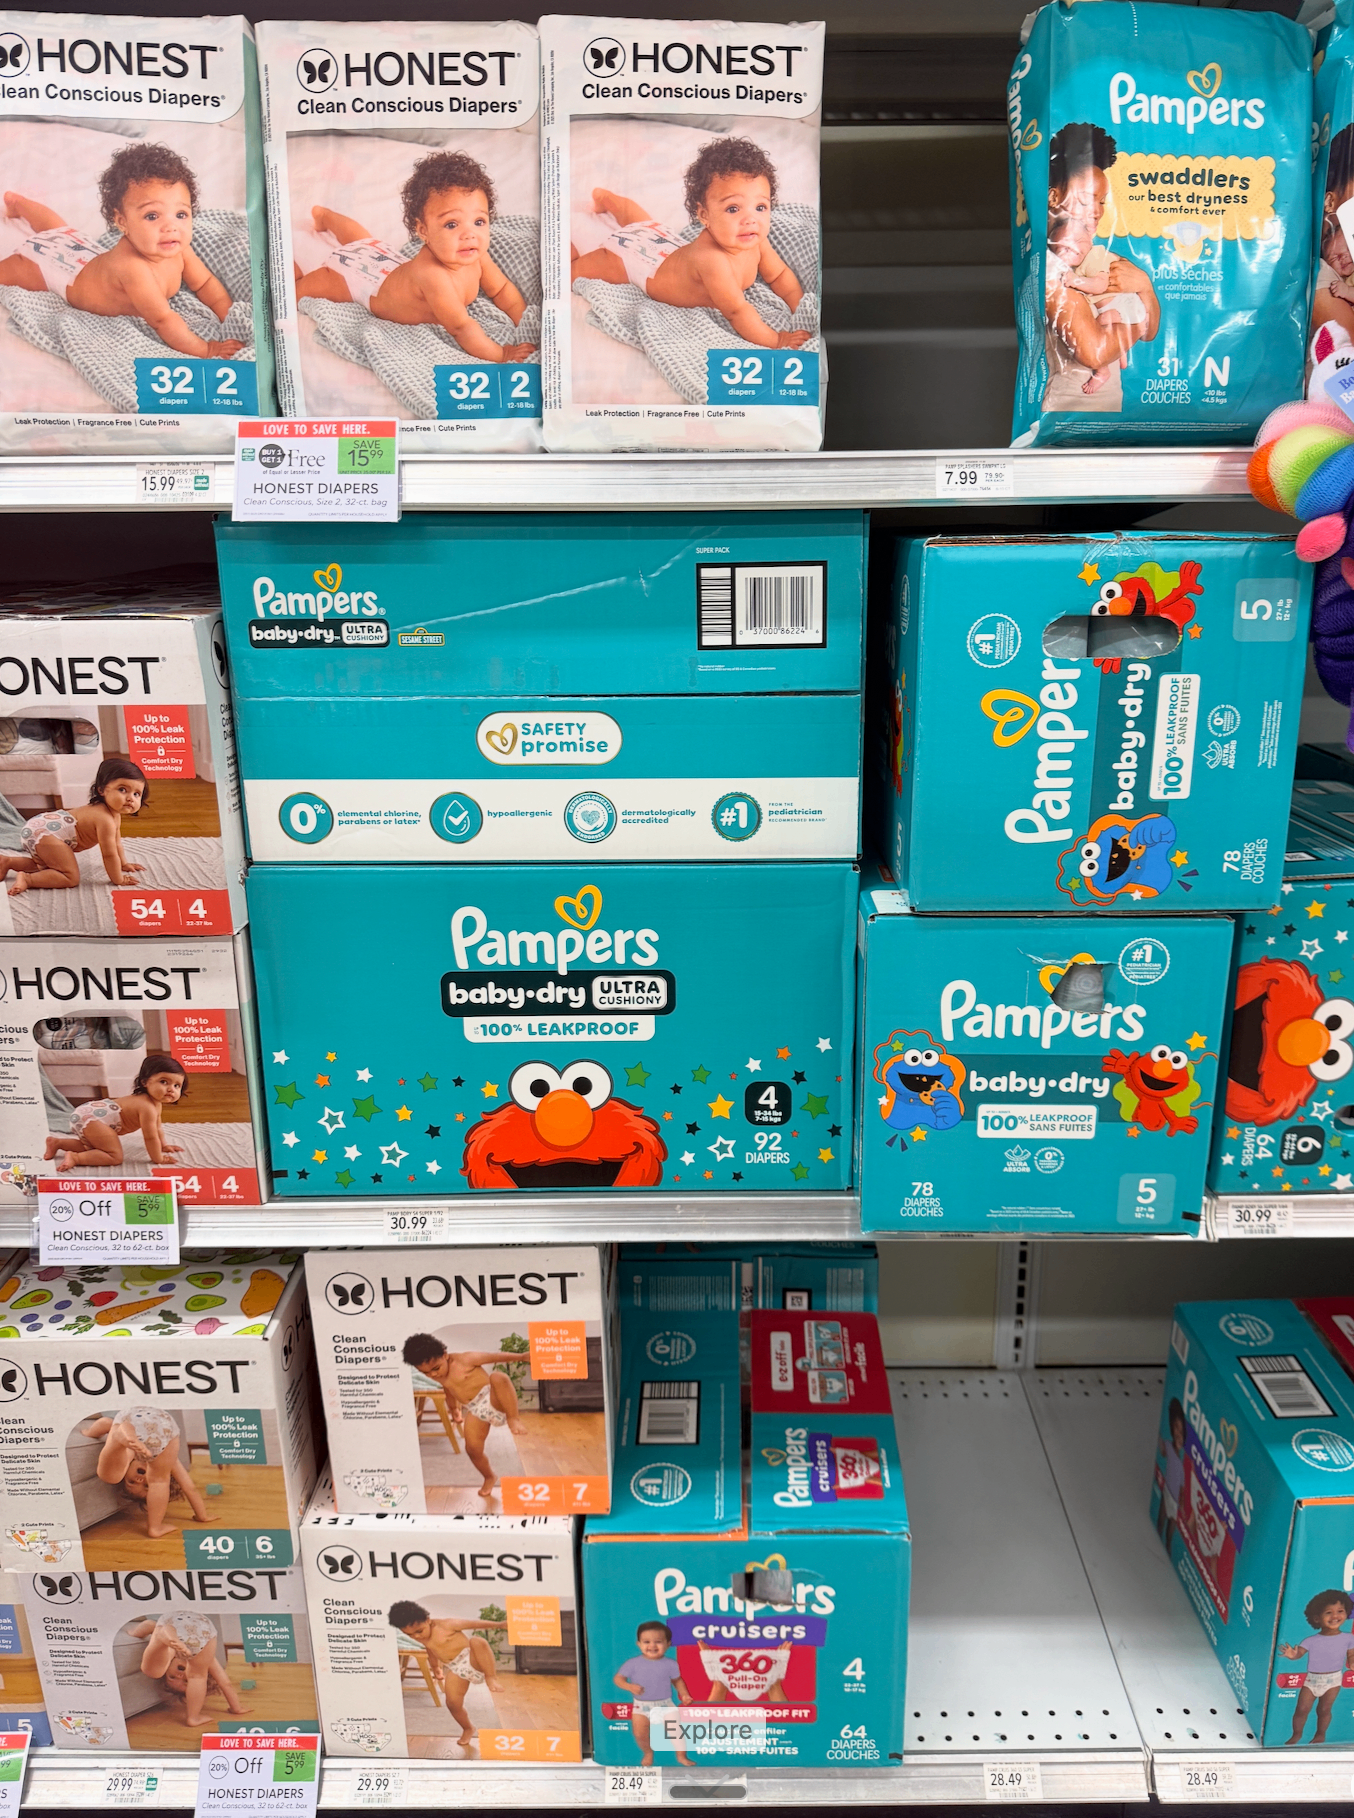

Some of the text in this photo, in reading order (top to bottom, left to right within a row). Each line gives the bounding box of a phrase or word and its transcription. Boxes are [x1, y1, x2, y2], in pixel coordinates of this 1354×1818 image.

[37, 38, 218, 80] HONEST
[632, 42, 804, 78] HONEST
[345, 51, 516, 87] HONEST
[0, 83, 221, 109] lean Conscious Diapers
[582, 83, 804, 105] Clean Conscious Diapers
[297, 96, 518, 116] Clean Conscious Diapers
[1109, 71, 1267, 135] Pampers
[1127, 168, 1251, 191] swaddlers
[1128, 190, 1248, 208] our best dryness
[1156, 205, 1199, 216] comfort
[1202, 208, 1226, 216] ever
[721, 357, 804, 385] 32 2
[1156, 355, 1231, 388] 31 N
[150, 365, 238, 395] 32 2
[449, 370, 531, 399] 32 2
[1145, 379, 1189, 392] DIAPERS
[1140, 391, 1192, 404] COUCHES
[585, 409, 746, 419] Leak Protection Fragrance Free Cute Prints
[263, 422, 371, 435] LOVE TO SAVE HERE.
[353, 439, 381, 450] SAVE
[287, 448, 326, 468] Free
[141, 476, 175, 491] 15.99
[945, 470, 978, 485] 7.99
[253, 482, 379, 495] HONEST DIAPERS
[243, 497, 388, 509] Clean Conscious, Size 2, 32-ct. bag
[695, 547, 714, 555] SUPER
[253, 576, 379, 623] Pampers
[1240, 598, 1274, 622] 5
[401, 635, 443, 644] SESAME STREET
[974, 633, 996, 656] #1
[0, 655, 160, 696] ONEST
[1165, 676, 1181, 746] LEAKPROOF
[1176, 676, 1192, 746] SANS FUITES
[521, 722, 587, 736] SAFETY
[134, 735, 185, 745] Protection
[521, 737, 609, 757] promise
[289, 801, 327, 835] 0%
[487, 809, 553, 818] hypoallergenic
[621, 808, 697, 818] dermatologically
[719, 801, 749, 829] #1
[768, 808, 823, 817] pediatrician
[621, 816, 669, 825] accredited
[1222, 849, 1241, 874] 78
[1240, 842, 1256, 881] DIAPERS
[1251, 838, 1269, 885] COUCHES
[130, 898, 208, 919] 54 4
[451, 906, 660, 976] Pampers
[13, 966, 200, 1001] HONEST
[600, 980, 661, 995] ULTRA
[599, 995, 662, 1006] CUSHIONY
[940, 979, 1147, 1050] Pampers
[479, 1022, 640, 1037] 100% LEAKPROOF
[175, 1034, 223, 1043] Protection
[757, 1085, 779, 1110] 4
[981, 1114, 1029, 1131] 100%
[1029, 1113, 1094, 1123] LEAKPROOF
[1029, 1123, 1093, 1133] SANS FUITES
[753, 1131, 782, 1151] 92
[1241, 1126, 1257, 1167] DIAPERS
[1255, 1133, 1276, 1160] 64
[1296, 1136, 1322, 1153] 6
[745, 1152, 791, 1164] DIAPERS
[59, 1182, 151, 1191] LOVE TO SAVE HERE.
[911, 1182, 934, 1197] 78
[1135, 1178, 1158, 1204] 5
[136, 1195, 161, 1204] SAVE
[903, 1196, 941, 1208] DIAPERS
[52, 1199, 112, 1217] 20% Off
[899, 1206, 944, 1218] COUCHES
[390, 1216, 427, 1230] 30.99
[1234, 1209, 1272, 1223] 30.99
[53, 1230, 164, 1242] HONEST DIAPERS
[381, 1272, 579, 1309] HONEST
[332, 1334, 367, 1345] Clean
[333, 1344, 397, 1355] Conscious
[335, 1354, 382, 1366] Diapers
[33, 1360, 250, 1396] HONEST
[1182, 1369, 1255, 1527] Pampers
[772, 1427, 814, 1508] Pampers
[517, 1482, 589, 1502] 32 7
[1190, 1443, 1237, 1532] cruisers
[199, 1535, 274, 1554] 40 6
[368, 1550, 553, 1583] HONEST
[88, 1570, 287, 1601] HONEST
[323, 1597, 355, 1607] Clean
[324, 1606, 383, 1616] Conscious
[43, 1616, 73, 1625] Clean
[325, 1616, 369, 1626] Diapers
[44, 1625, 99, 1634] Conscious
[691, 1621, 807, 1640] cruisers
[46, 1633, 86, 1642] Diapers
[842, 1657, 866, 1682] 4
[729, 1681, 766, 1692] Diaper
[716, 1708, 790, 1719] LEAKPROOF
[791, 1708, 812, 1719] FIT
[839, 1724, 868, 1740] 64
[219, 1738, 300, 1748] LOVE TO SAVE HERE.
[831, 1739, 877, 1751] DIAPERS
[726, 1746, 758, 1756] SANS
[759, 1746, 800, 1756] FUITES
[826, 1749, 881, 1761] COUCHES
[210, 1757, 264, 1774] 20% Off
[357, 1777, 390, 1791] 29.99
[611, 1776, 643, 1790] 28.49
[990, 1772, 1022, 1786] 28.49
[1186, 1772, 1218, 1786] 28.49
[207, 1788, 304, 1799] HONEST DIAPERS
